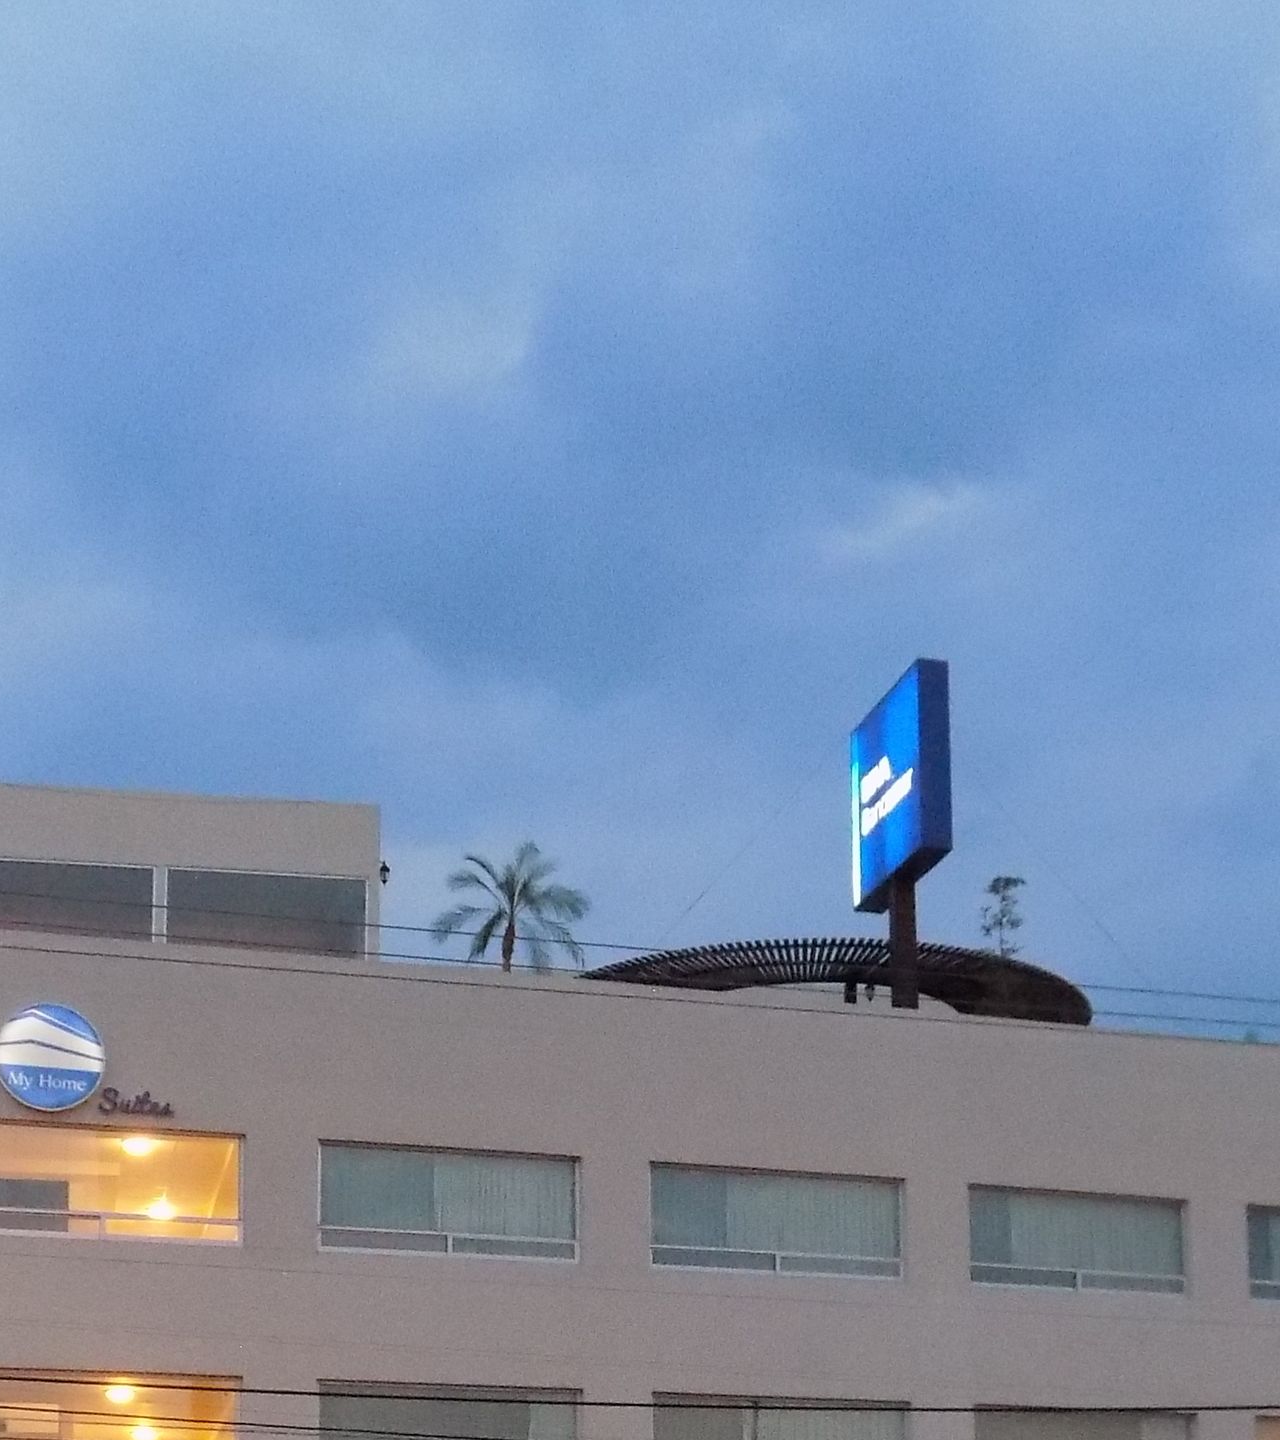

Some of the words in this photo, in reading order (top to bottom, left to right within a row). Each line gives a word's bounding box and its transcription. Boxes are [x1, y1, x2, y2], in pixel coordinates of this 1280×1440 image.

[7, 1071, 33, 1091] My
[39, 1074, 88, 1092] Home
[99, 1087, 175, 1118] Suites
